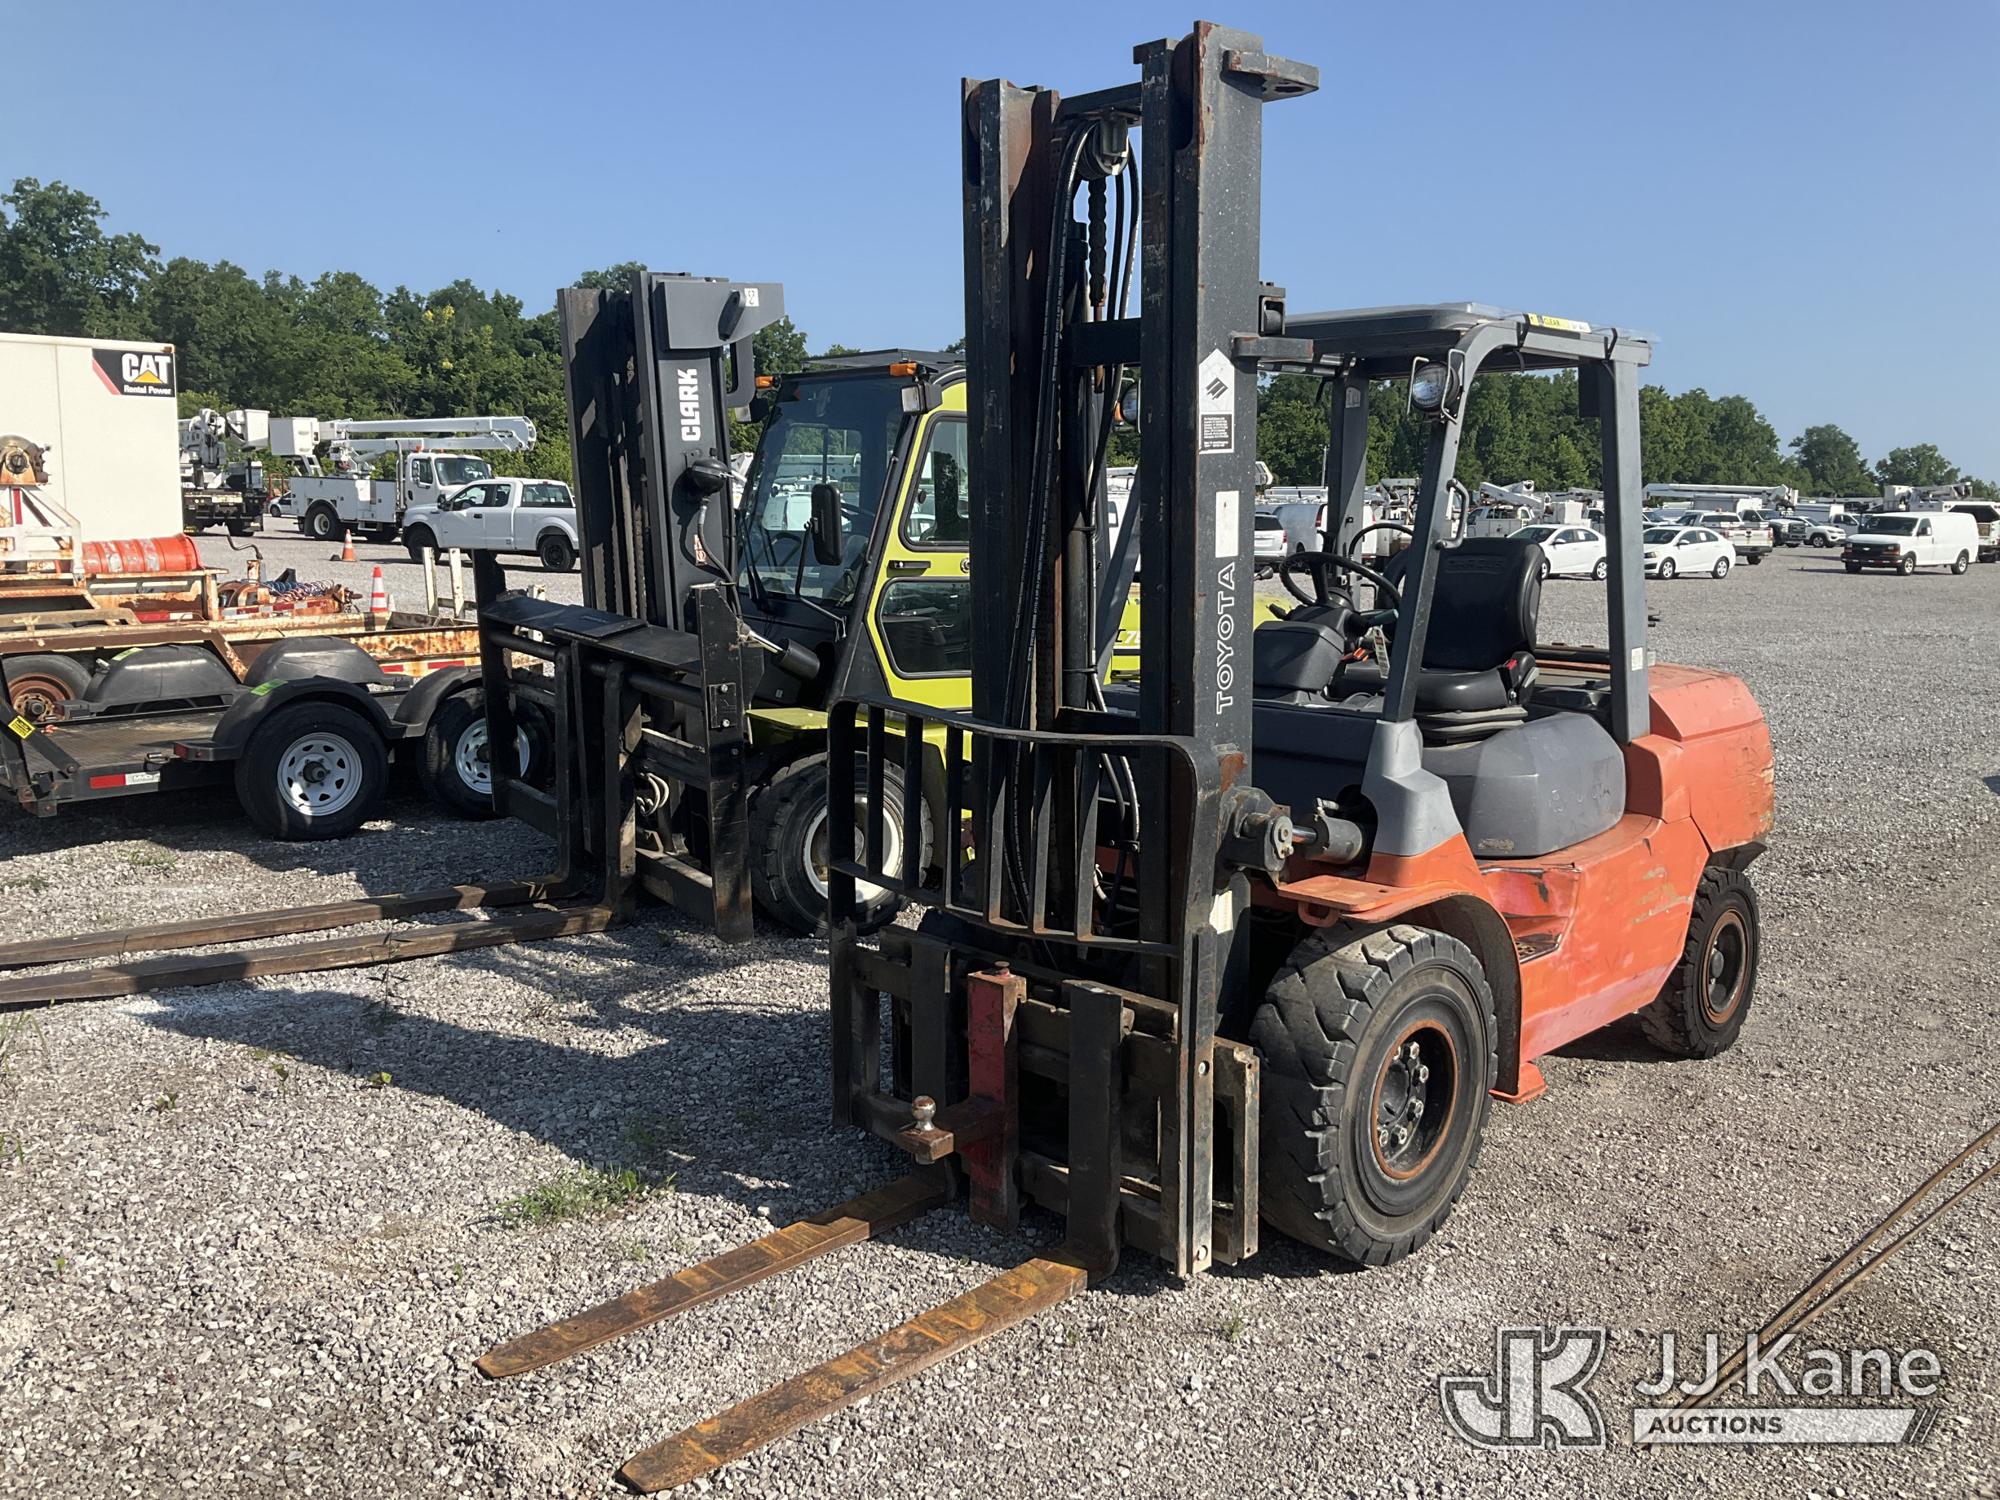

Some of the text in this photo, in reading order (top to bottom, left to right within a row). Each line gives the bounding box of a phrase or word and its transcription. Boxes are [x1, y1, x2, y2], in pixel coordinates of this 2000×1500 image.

[122, 353, 171, 384] CAT
[124, 385, 172, 395] Rental Power
[677, 368, 701, 442] CLARK
[1216, 561, 1235, 715] TOYOTA
